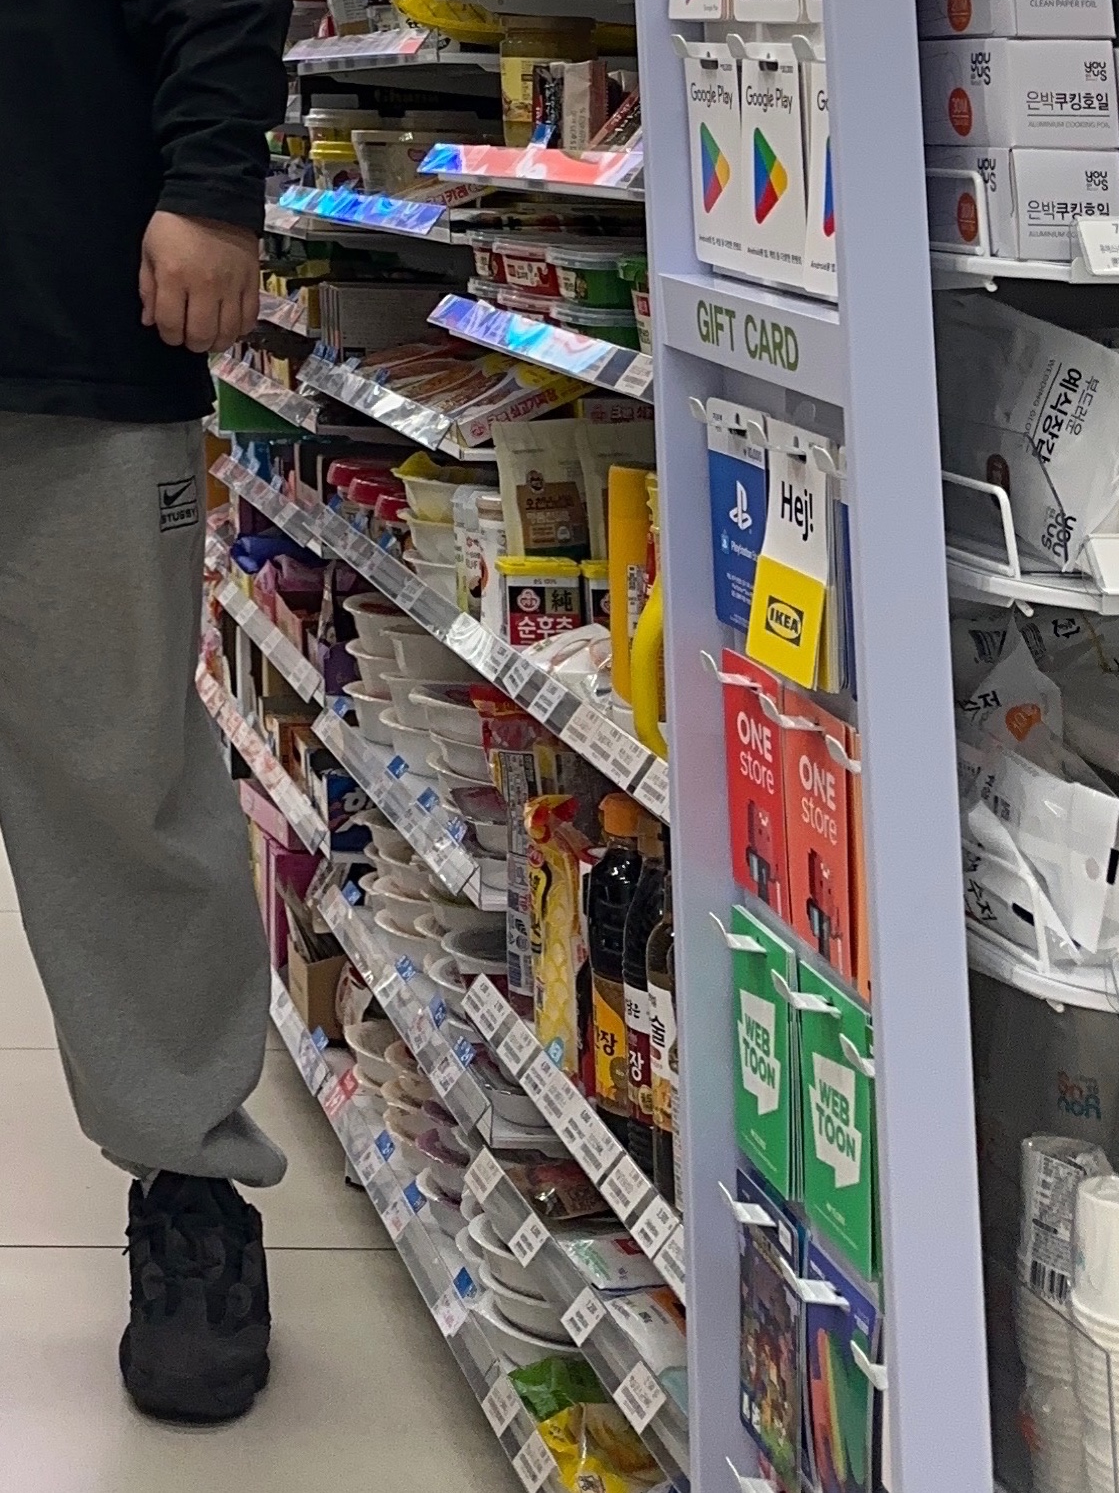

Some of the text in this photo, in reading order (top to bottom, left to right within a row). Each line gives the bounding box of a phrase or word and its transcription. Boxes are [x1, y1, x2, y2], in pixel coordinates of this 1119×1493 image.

[1030, 0, 1054, 8] CLEAN
[1056, 0, 1079, 8] PAPER
[690, 82, 733, 110] Google Play
[746, 86, 793, 115] Google Play
[1026, 91, 1110, 111] 은박쿠킹호일
[696, 300, 799, 372] GIFT CARD
[1065, 375, 1100, 436] 부드러운
[159, 508, 196, 525] STUSSY
[780, 480, 814, 542] Hej!
[770, 607, 799, 634] IKEA
[737, 709, 773, 762] ONE
[739, 750, 775, 796] store
[798, 754, 836, 812] ONE
[801, 795, 837, 846] store
[744, 1014, 771, 1058] WEB
[742, 1038, 776, 1089] TOON
[818, 1078, 850, 1128] WEB
[815, 1102, 856, 1163] TOON
